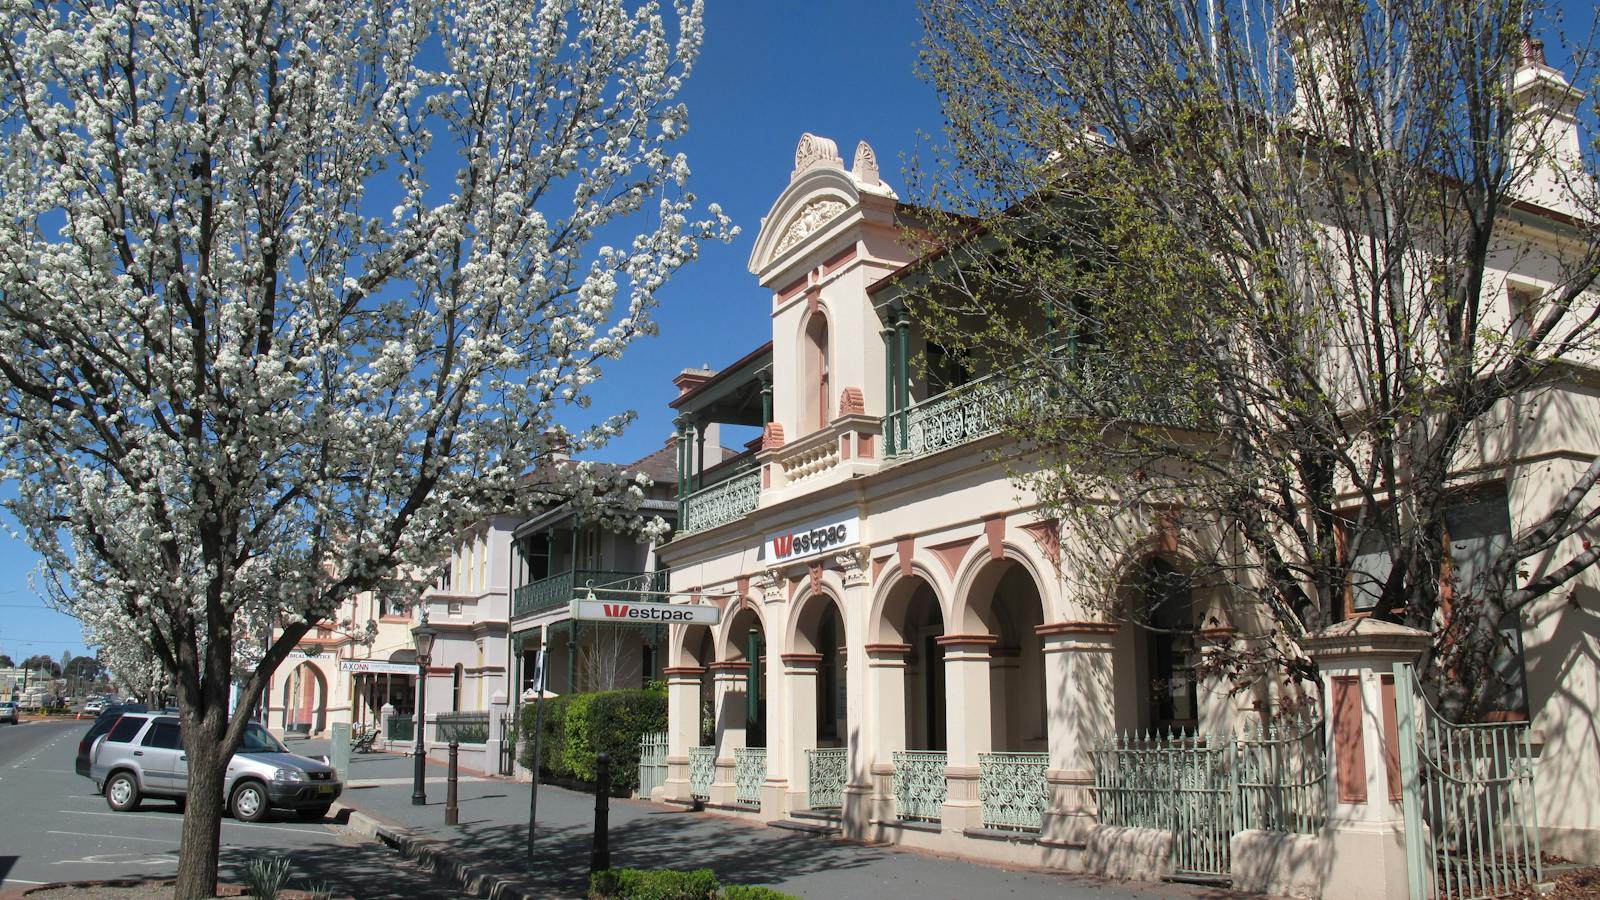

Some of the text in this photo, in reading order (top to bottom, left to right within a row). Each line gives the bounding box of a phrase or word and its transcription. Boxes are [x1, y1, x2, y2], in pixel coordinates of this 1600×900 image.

[773, 523, 847, 560] Westpac
[603, 604, 694, 621] Westpac
[342, 663, 369, 671] AXONN
